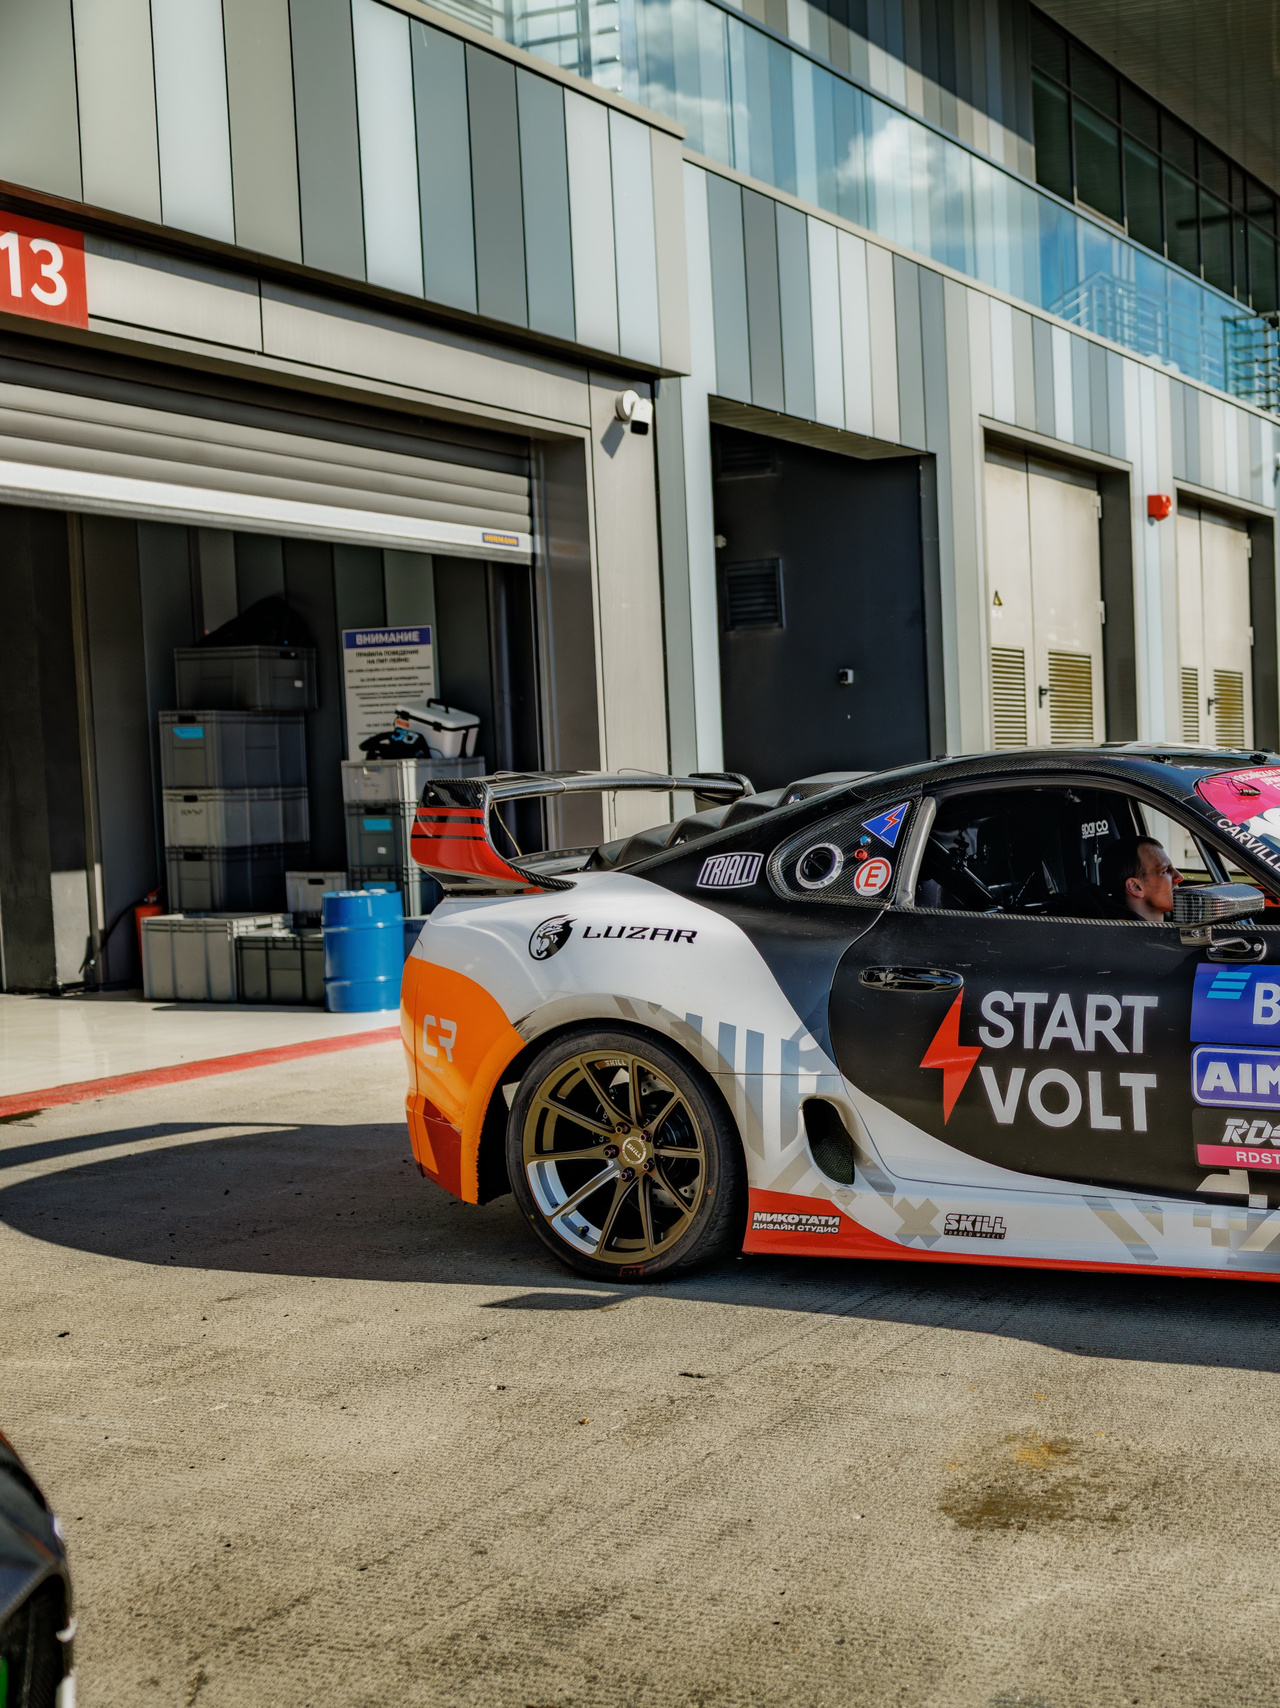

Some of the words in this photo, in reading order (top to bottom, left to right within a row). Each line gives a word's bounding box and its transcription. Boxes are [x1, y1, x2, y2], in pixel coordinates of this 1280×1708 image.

[0, 230, 68, 307] 13
[355, 630, 421, 646] ВНИМАНИЕ
[702, 855, 759, 886] TRIALLI
[863, 866, 882, 887] E
[582, 926, 698, 944] LUZAR
[978, 990, 1159, 1054] START
[423, 1014, 457, 1063] CR
[604, 1059, 627, 1067] SKILL
[979, 1066, 1157, 1132] VOLT
[752, 1222, 795, 1231] ДИЗАЙН
[797, 1225, 839, 1234] СТУДИО
[753, 1212, 840, 1225] МИКОТАТИ
[945, 1214, 1006, 1233] SKILL
